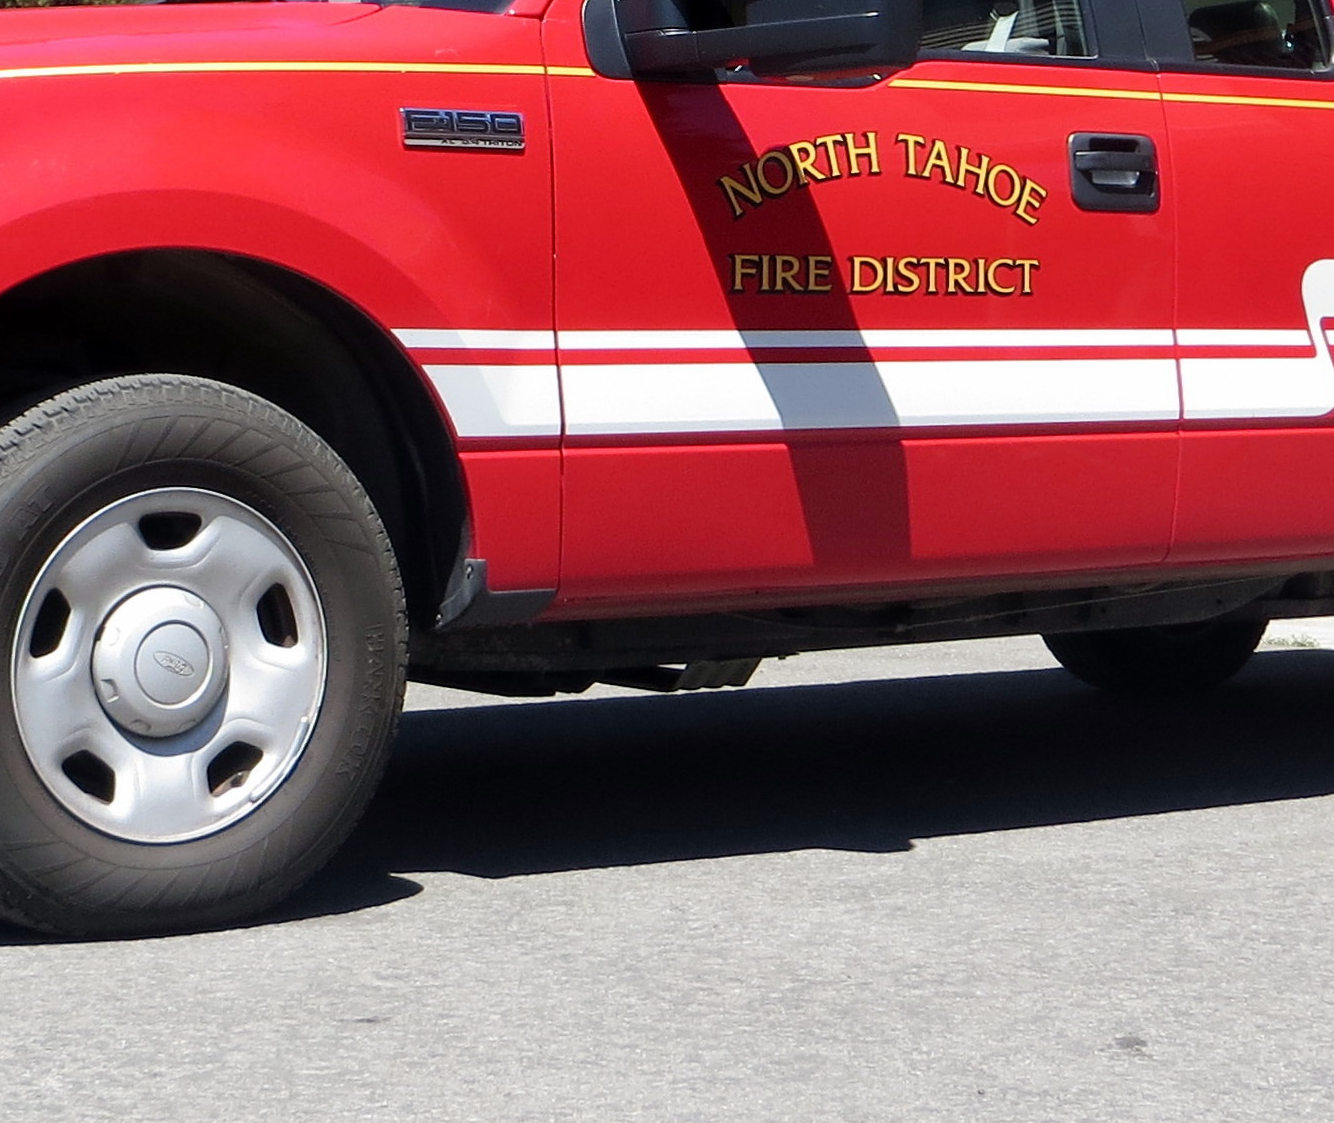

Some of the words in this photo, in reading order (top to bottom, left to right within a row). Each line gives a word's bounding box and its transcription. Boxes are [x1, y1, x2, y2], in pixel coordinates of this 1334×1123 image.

[718, 132, 881, 218] NORTH
[896, 133, 1048, 225] TAHOE
[731, 255, 834, 293] FIRE
[850, 256, 1041, 294] DISTRICT
